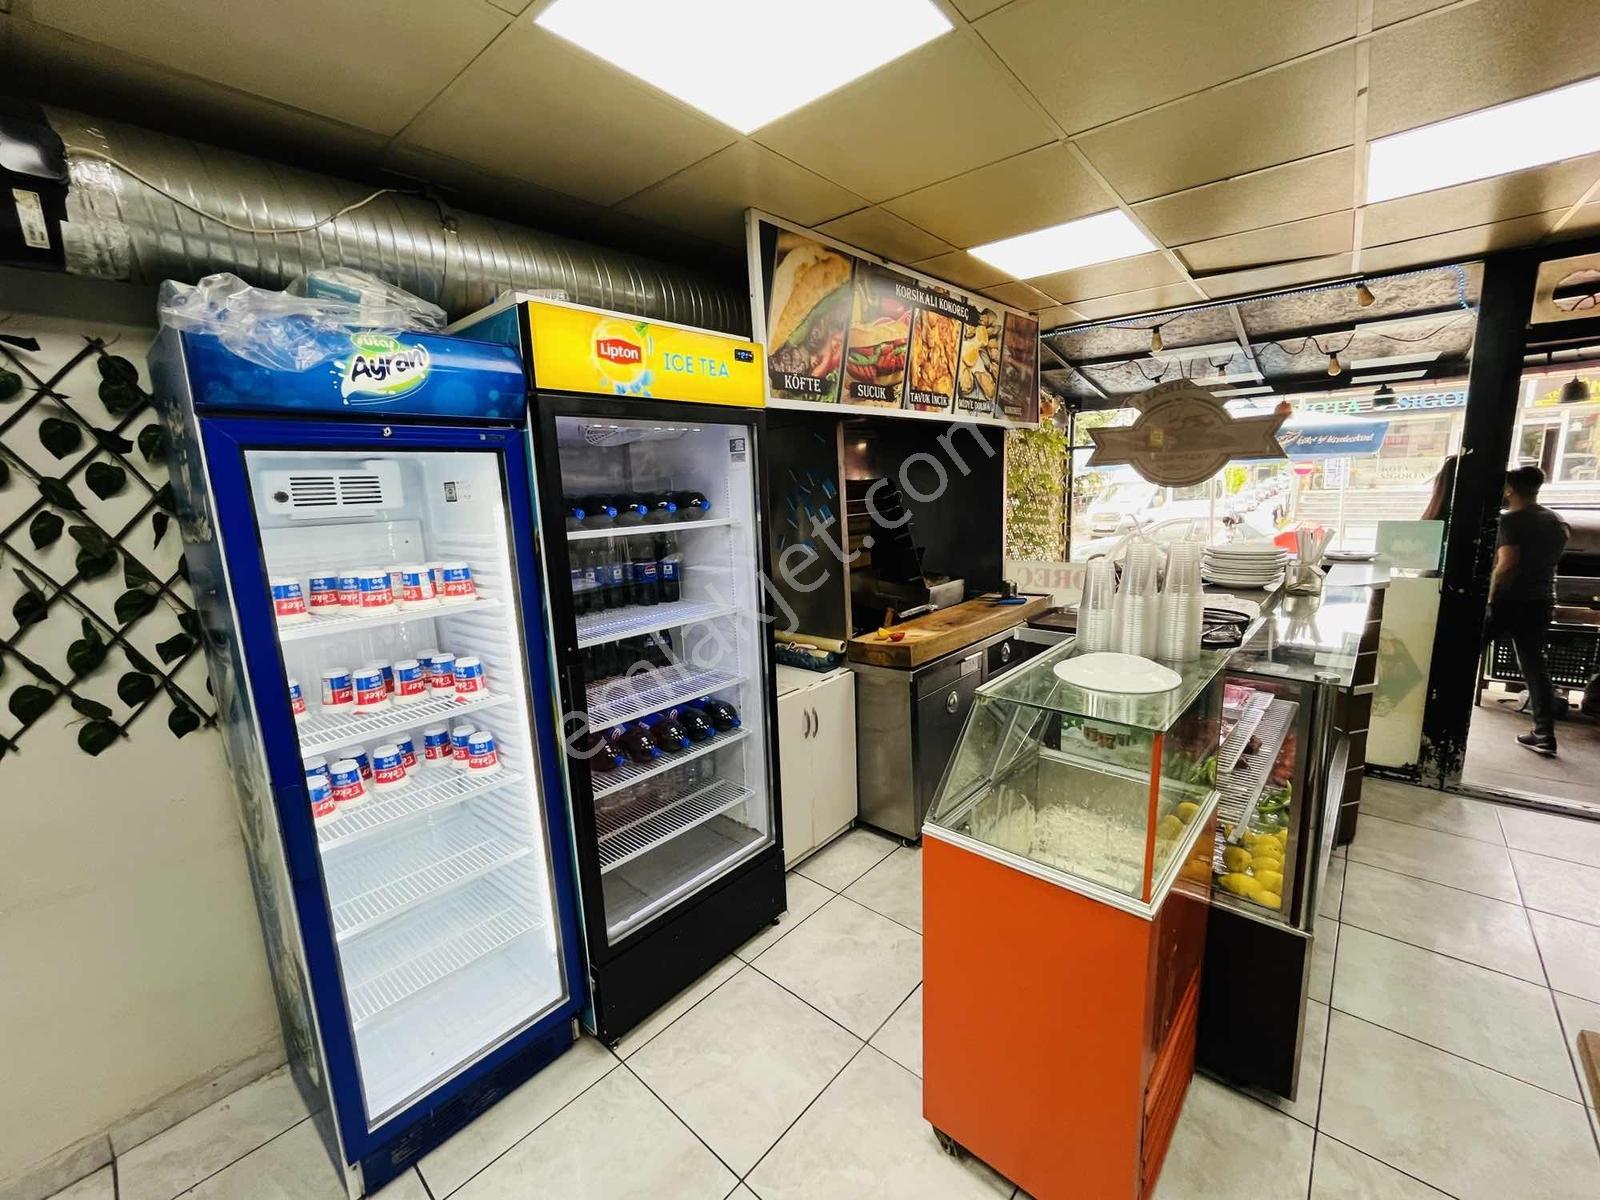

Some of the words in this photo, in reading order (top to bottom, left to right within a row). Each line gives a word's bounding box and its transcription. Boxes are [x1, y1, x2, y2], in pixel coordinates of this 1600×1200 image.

[600, 340, 639, 361] Lipton
[351, 348, 424, 382] Ayran
[664, 352, 694, 374] ICE
[700, 357, 729, 377] TEA
[784, 373, 821, 392] KÖFTE
[857, 384, 886, 399] SUCUK
[910, 392, 930, 404] TAVUK
